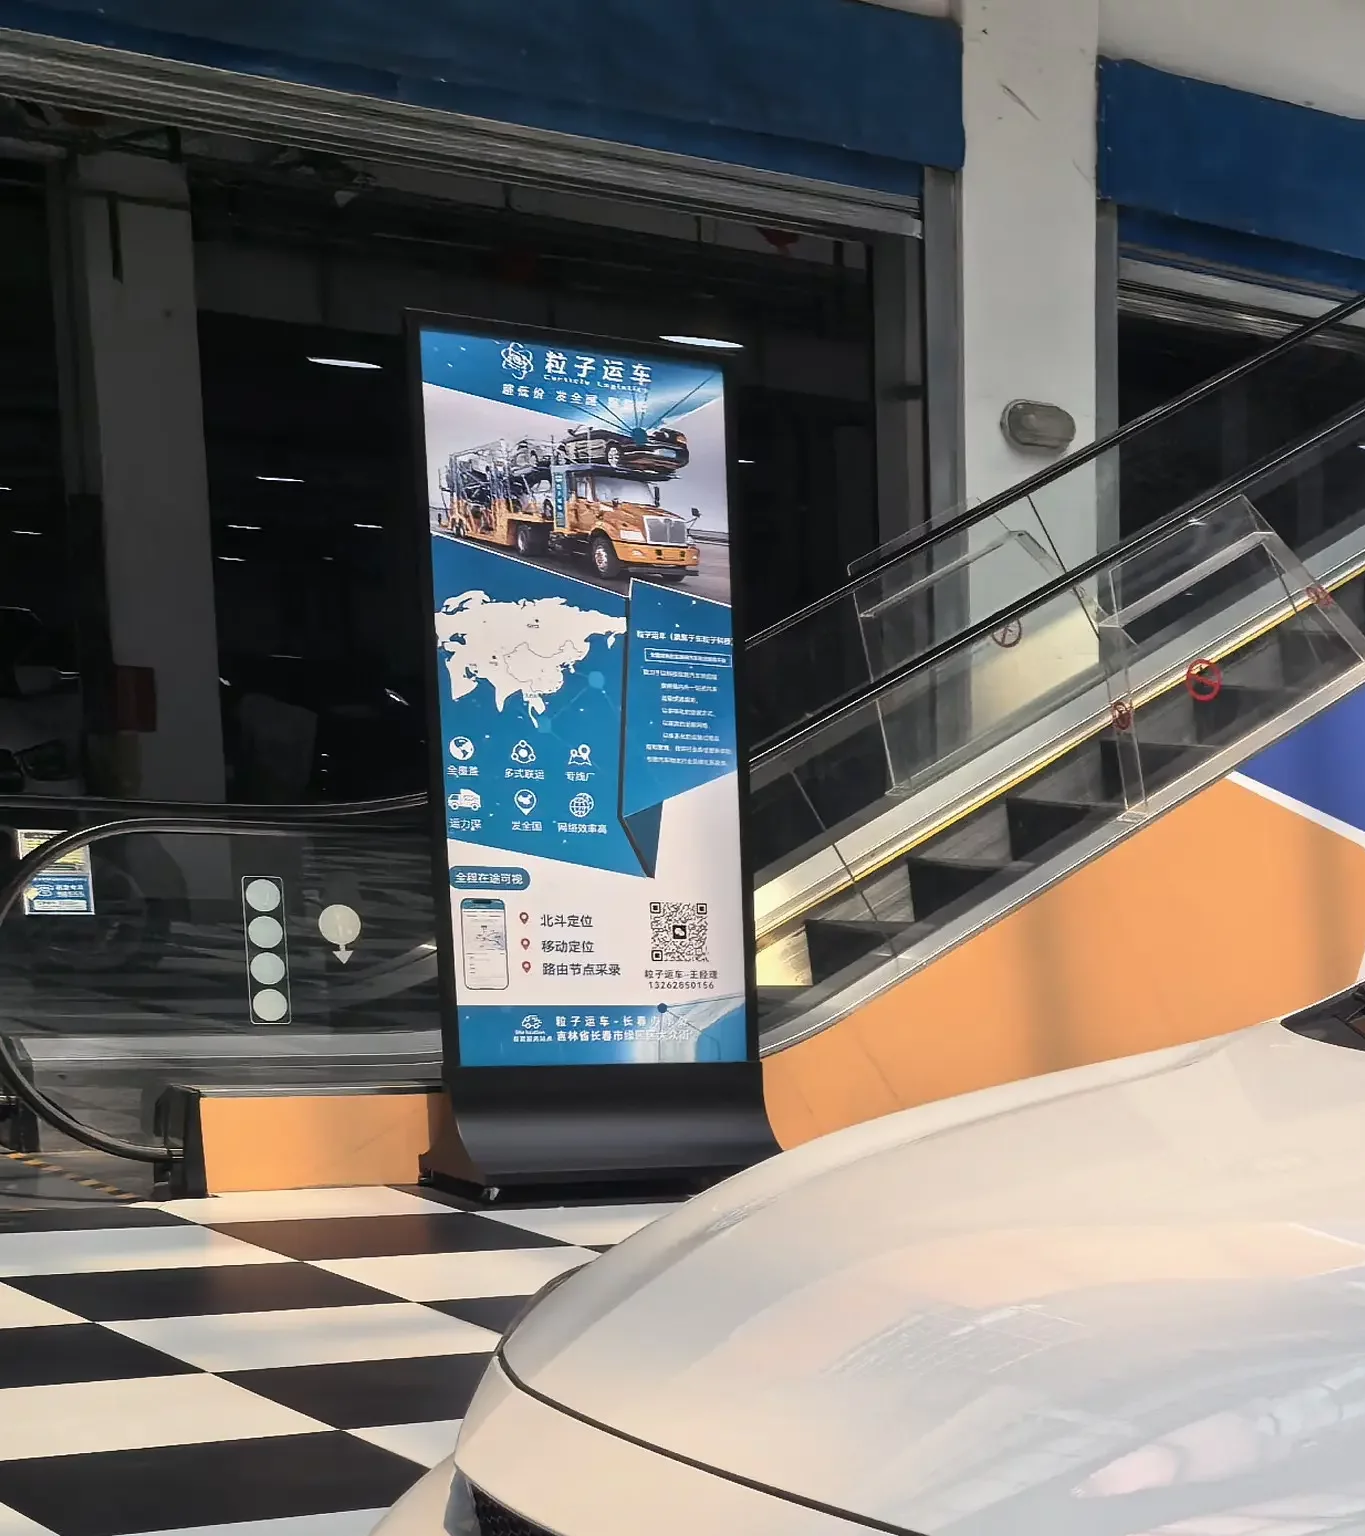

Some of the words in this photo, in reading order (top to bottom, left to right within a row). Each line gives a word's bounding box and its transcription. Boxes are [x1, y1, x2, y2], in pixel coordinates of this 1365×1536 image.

[544, 351, 652, 386] 粒子运车
[540, 914, 593, 928] 北斗定位
[541, 940, 595, 954] 移动定位
[542, 962, 621, 977] 路由节点采录
